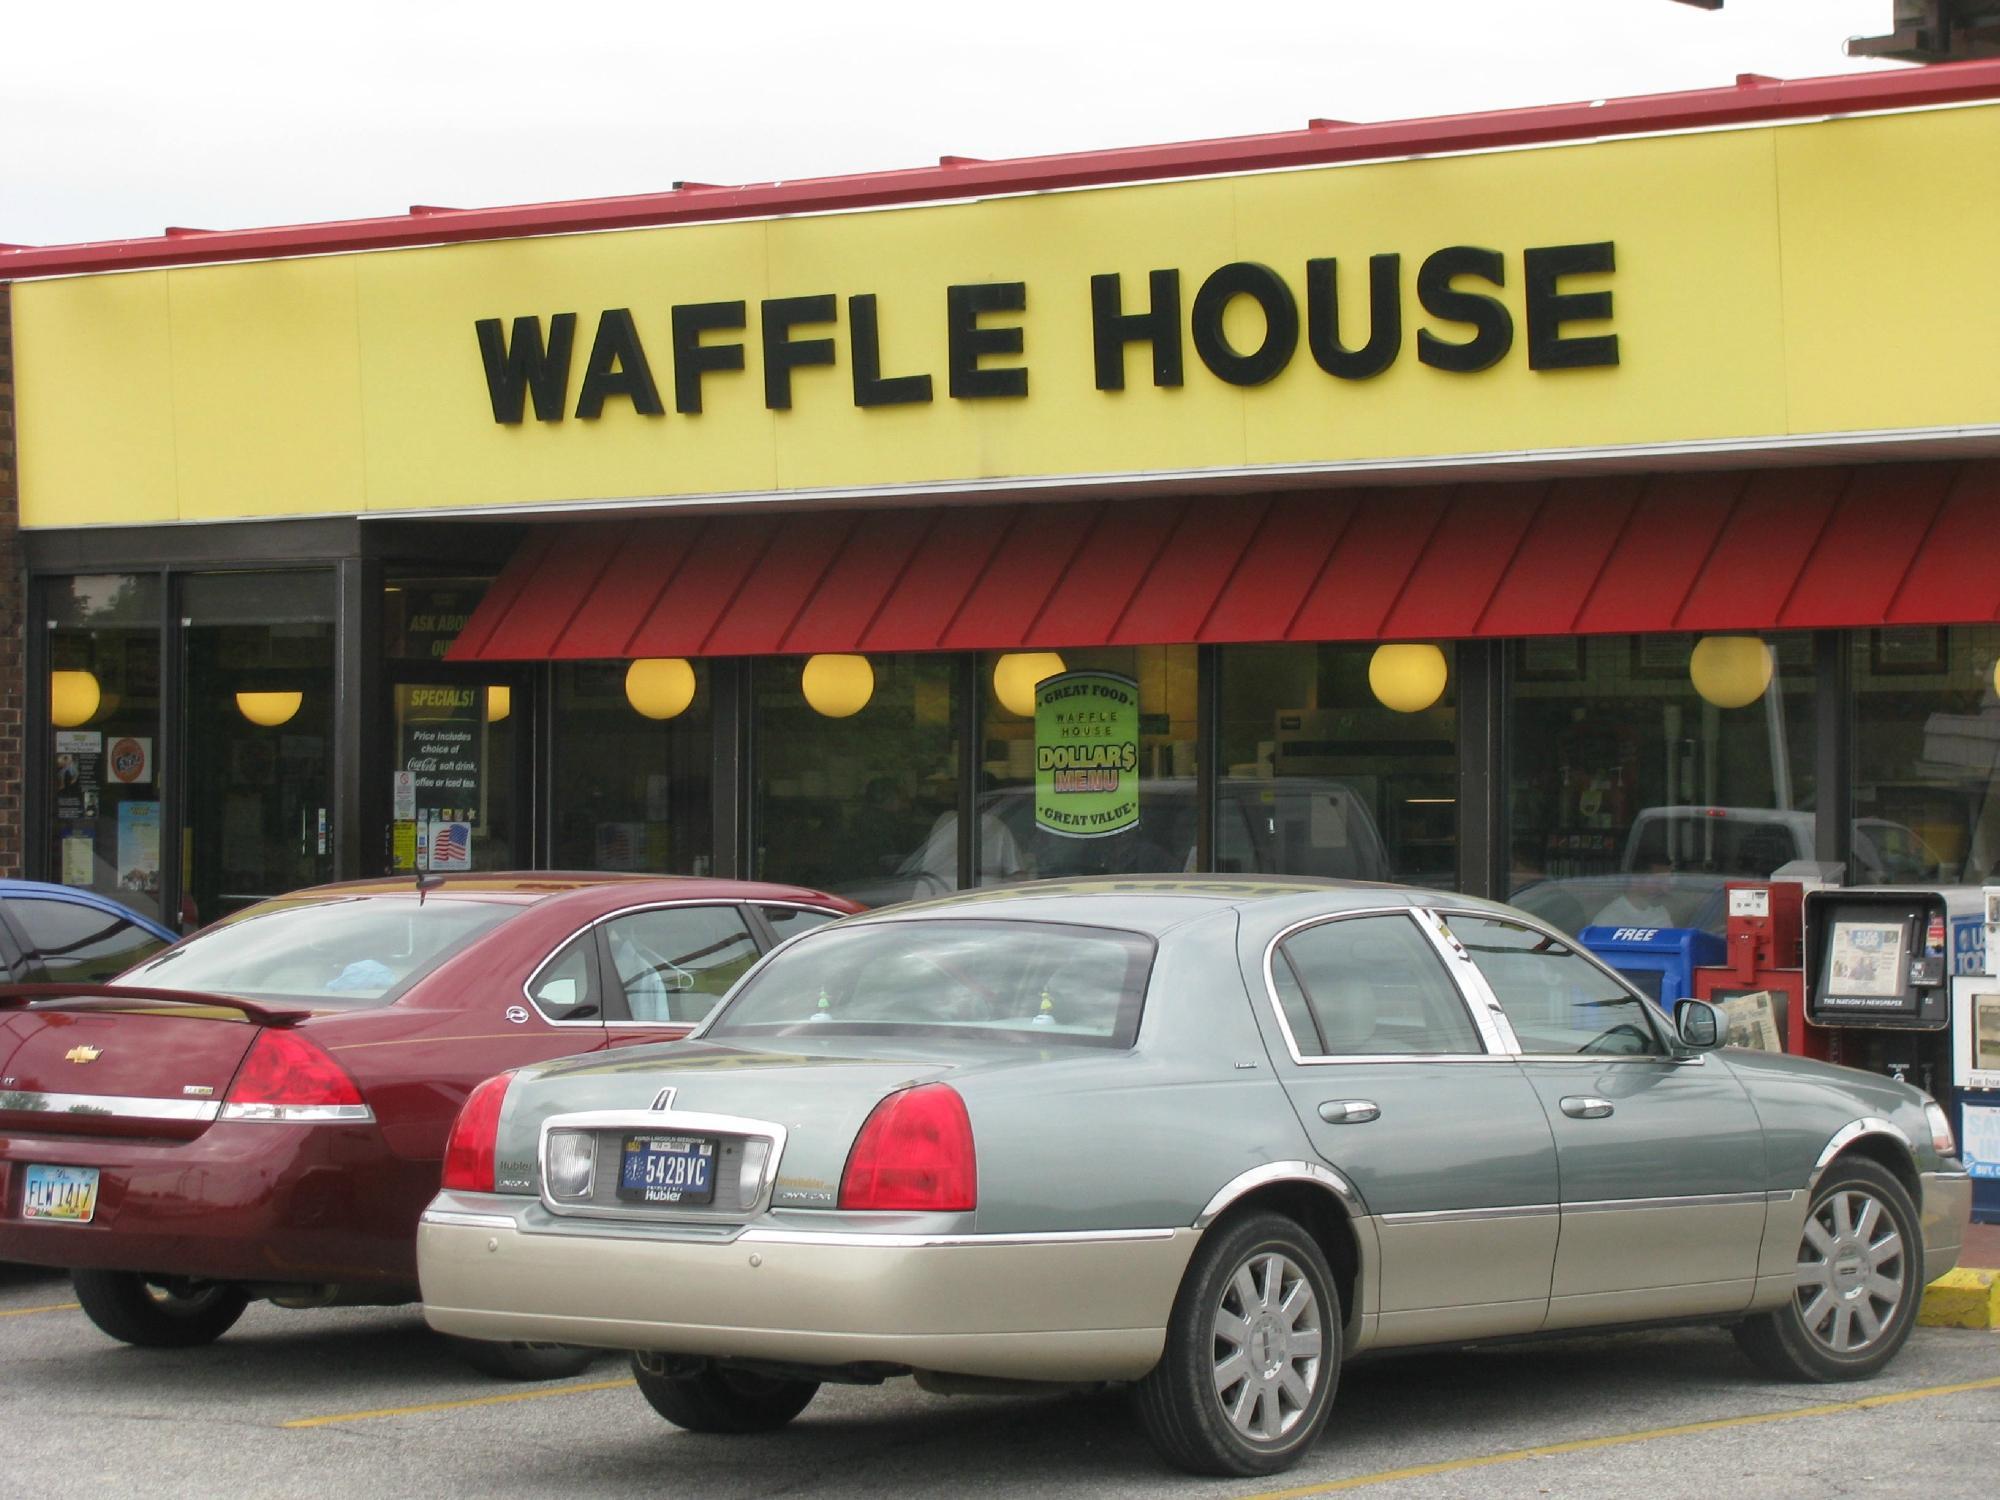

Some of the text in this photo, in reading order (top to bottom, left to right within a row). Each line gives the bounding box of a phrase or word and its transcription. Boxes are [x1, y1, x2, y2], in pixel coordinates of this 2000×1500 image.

[475, 241, 1620, 425] WAFFLE HOUSE
[409, 614, 470, 631] ASK ABO
[431, 640, 452, 657] OU
[411, 690, 475, 707] SPECIALS!
[1044, 684, 1129, 705] GREAT FOOD
[1056, 711, 1118, 737] WAFFLE HOUSE
[413, 731, 436, 741] Price
[421, 744, 460, 754] choice of
[439, 761, 455, 771] soft
[415, 777, 435, 787] offee
[435, 779, 444, 787] or
[445, 778, 463, 788] iced
[1055, 768, 1120, 794] MENU
[1044, 802, 1132, 826] GREAT VALUE
[1612, 928, 1660, 941] FREE
[1866, 999, 1903, 1007] NEWSPAPER
[645, 1155, 706, 1186] 542BVC
[644, 1190, 682, 1202] Hubler
